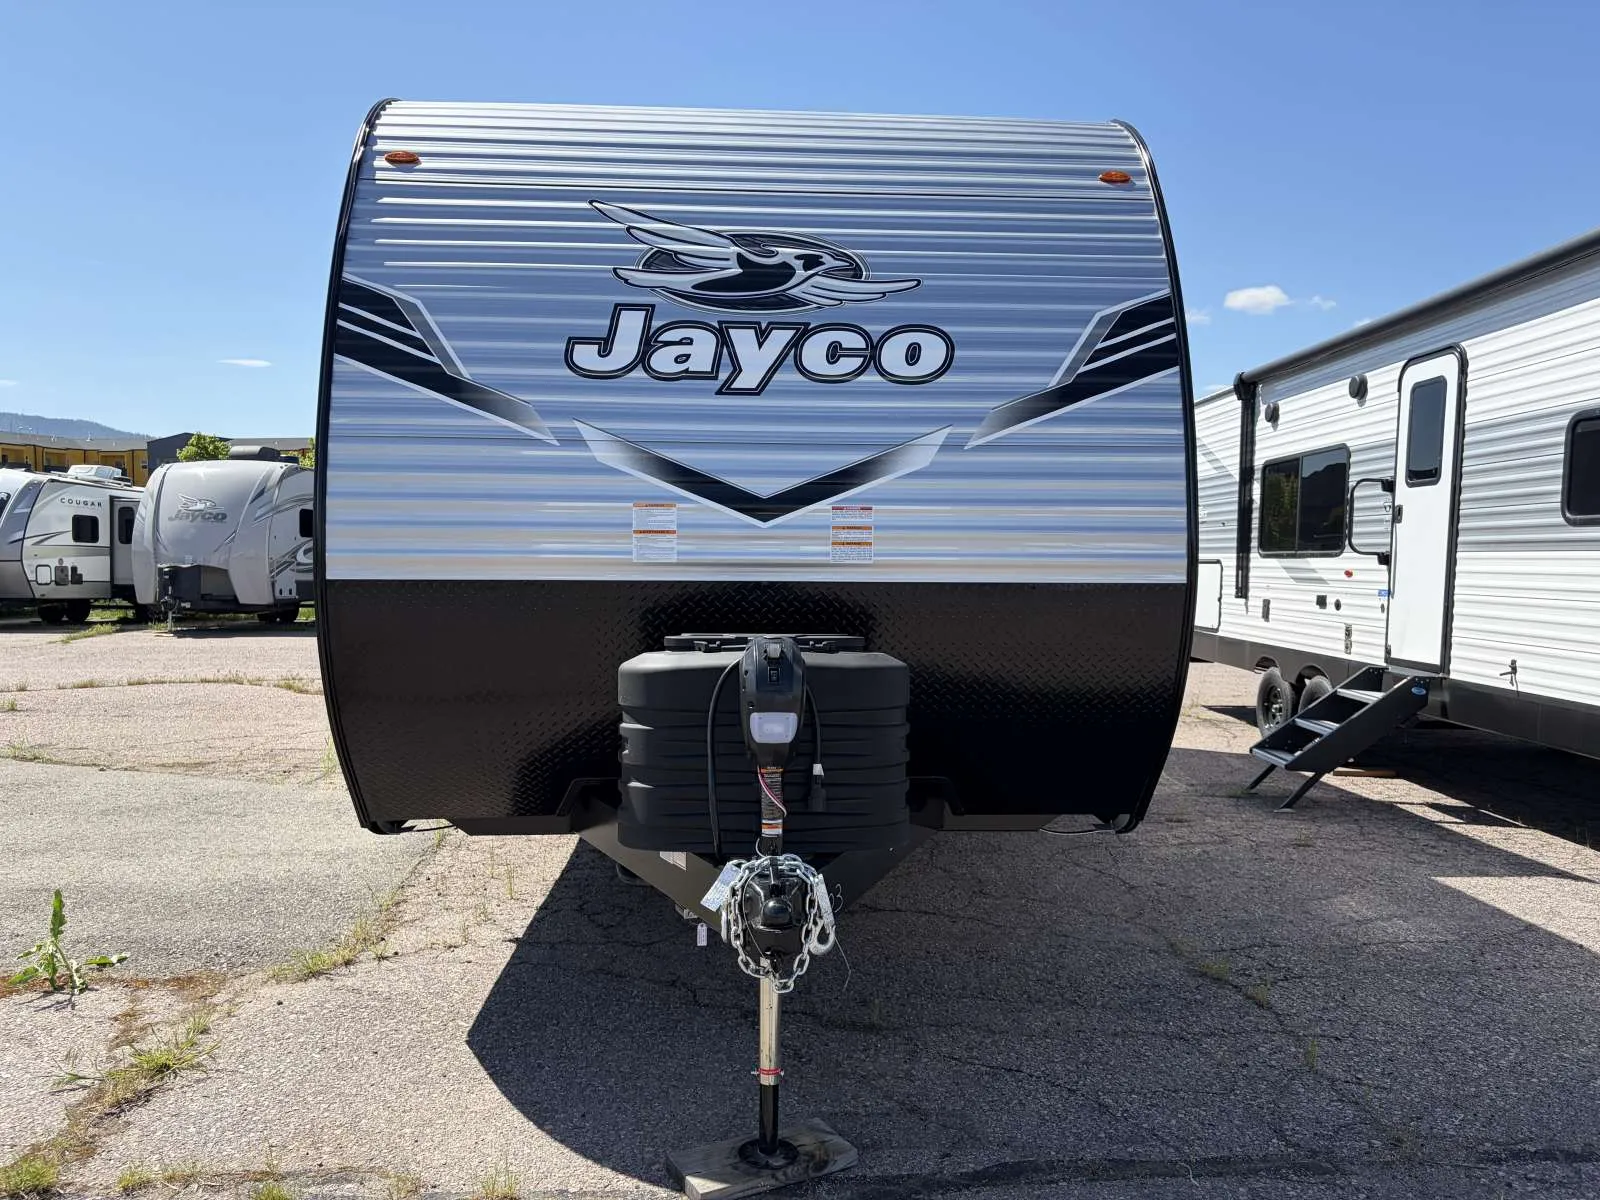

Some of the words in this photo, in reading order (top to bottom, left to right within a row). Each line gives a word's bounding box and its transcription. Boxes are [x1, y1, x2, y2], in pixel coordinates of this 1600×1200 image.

[564, 303, 955, 396] Jayco
[60, 497, 102, 507] COUGAR
[168, 509, 227, 523] Jayco
